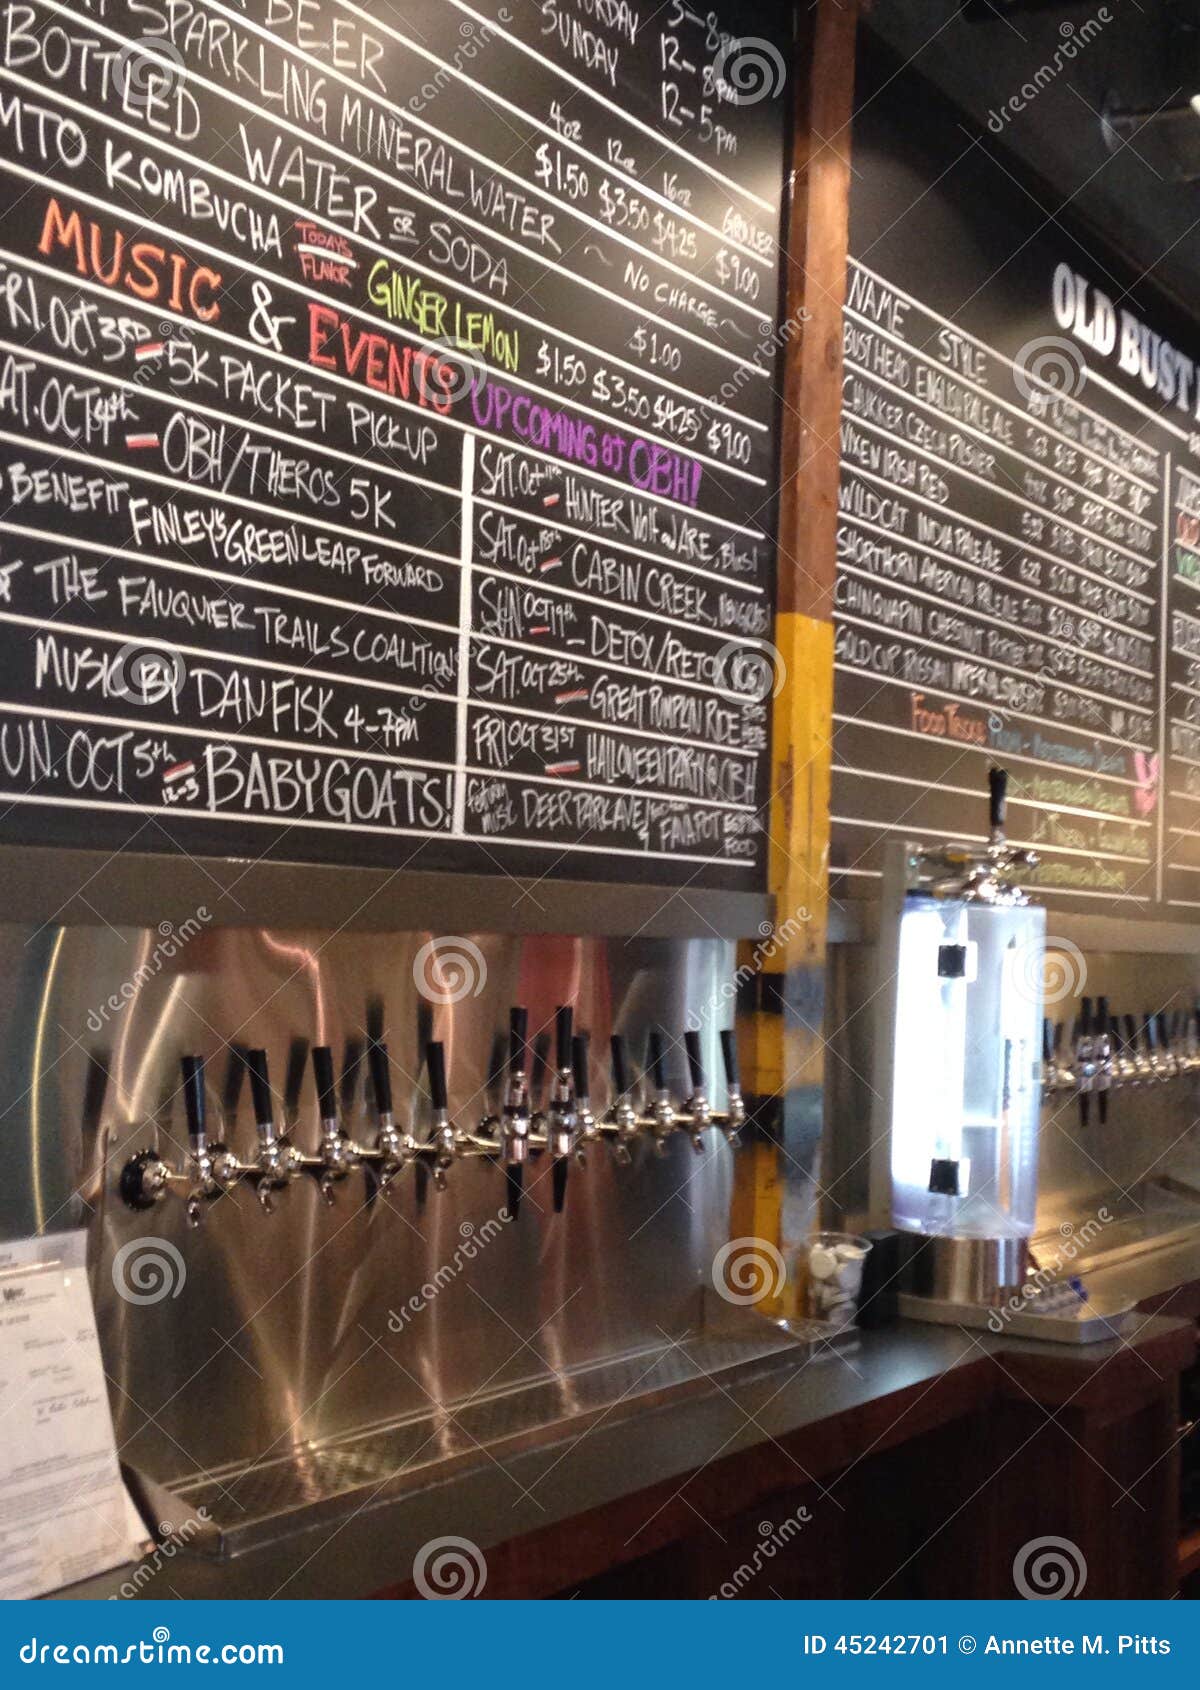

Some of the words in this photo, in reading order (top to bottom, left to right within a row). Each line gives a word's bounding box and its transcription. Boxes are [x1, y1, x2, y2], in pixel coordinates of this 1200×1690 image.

[541, 2, 619, 87] SUNDAY
[3, 4, 201, 141] BOTTLED
[239, 123, 381, 240] WATER
[428, 221, 509, 297] SODA
[654, 282, 719, 330] CHARGE
[129, 0, 327, 136] SPARKLING
[341, 94, 465, 199] MINERAL
[470, 168, 562, 254] WATER
[534, 142, 590, 200] $1.50
[599, 179, 650, 230] $3.50
[652, 212, 698, 260] $4.25
[715, 247, 760, 299] $9.00
[104, 139, 283, 259] KOMBUCHA
[366, 259, 448, 339] GINGER
[454, 301, 520, 373] LEMON
[629, 325, 682, 372] $1.00
[38, 197, 222, 321] MUSIC
[248, 280, 296, 352] &
[307, 302, 457, 417] EVENTS
[535, 338, 588, 387] $1.50
[591, 366, 652, 420] $3.50
[706, 417, 753, 466] $9.00
[847, 269, 912, 340] NAME
[937, 328, 988, 385] STYLE
[1052, 261, 1117, 357] OLD
[1117, 307, 1194, 413] BUST
[168, 339, 219, 388] 5K
[220, 354, 337, 433] PACKET
[470, 376, 599, 468] UPCOMING
[628, 438, 704, 509] OBH!
[7, 462, 131, 515] BENEFIT
[224, 518, 300, 566] GREEN
[301, 533, 361, 575] LEAP
[361, 554, 444, 593] FORWARD
[349, 477, 396, 529] 5K
[838, 479, 910, 533] WILDCAT
[33, 554, 109, 604] THE
[118, 575, 257, 630] FAUQUIER
[253, 605, 351, 658] TRAILS
[352, 628, 456, 677] COALITION
[571, 543, 642, 603] CABIN
[35, 634, 130, 699] MUSIC
[189, 668, 267, 724] DAN
[271, 678, 339, 739] FISK
[589, 674, 647, 729] GREAT
[66, 729, 135, 794] OCT
[202, 744, 322, 814] BABY
[322, 757, 454, 829] GOATS!
[521, 788, 573, 831] DEER
